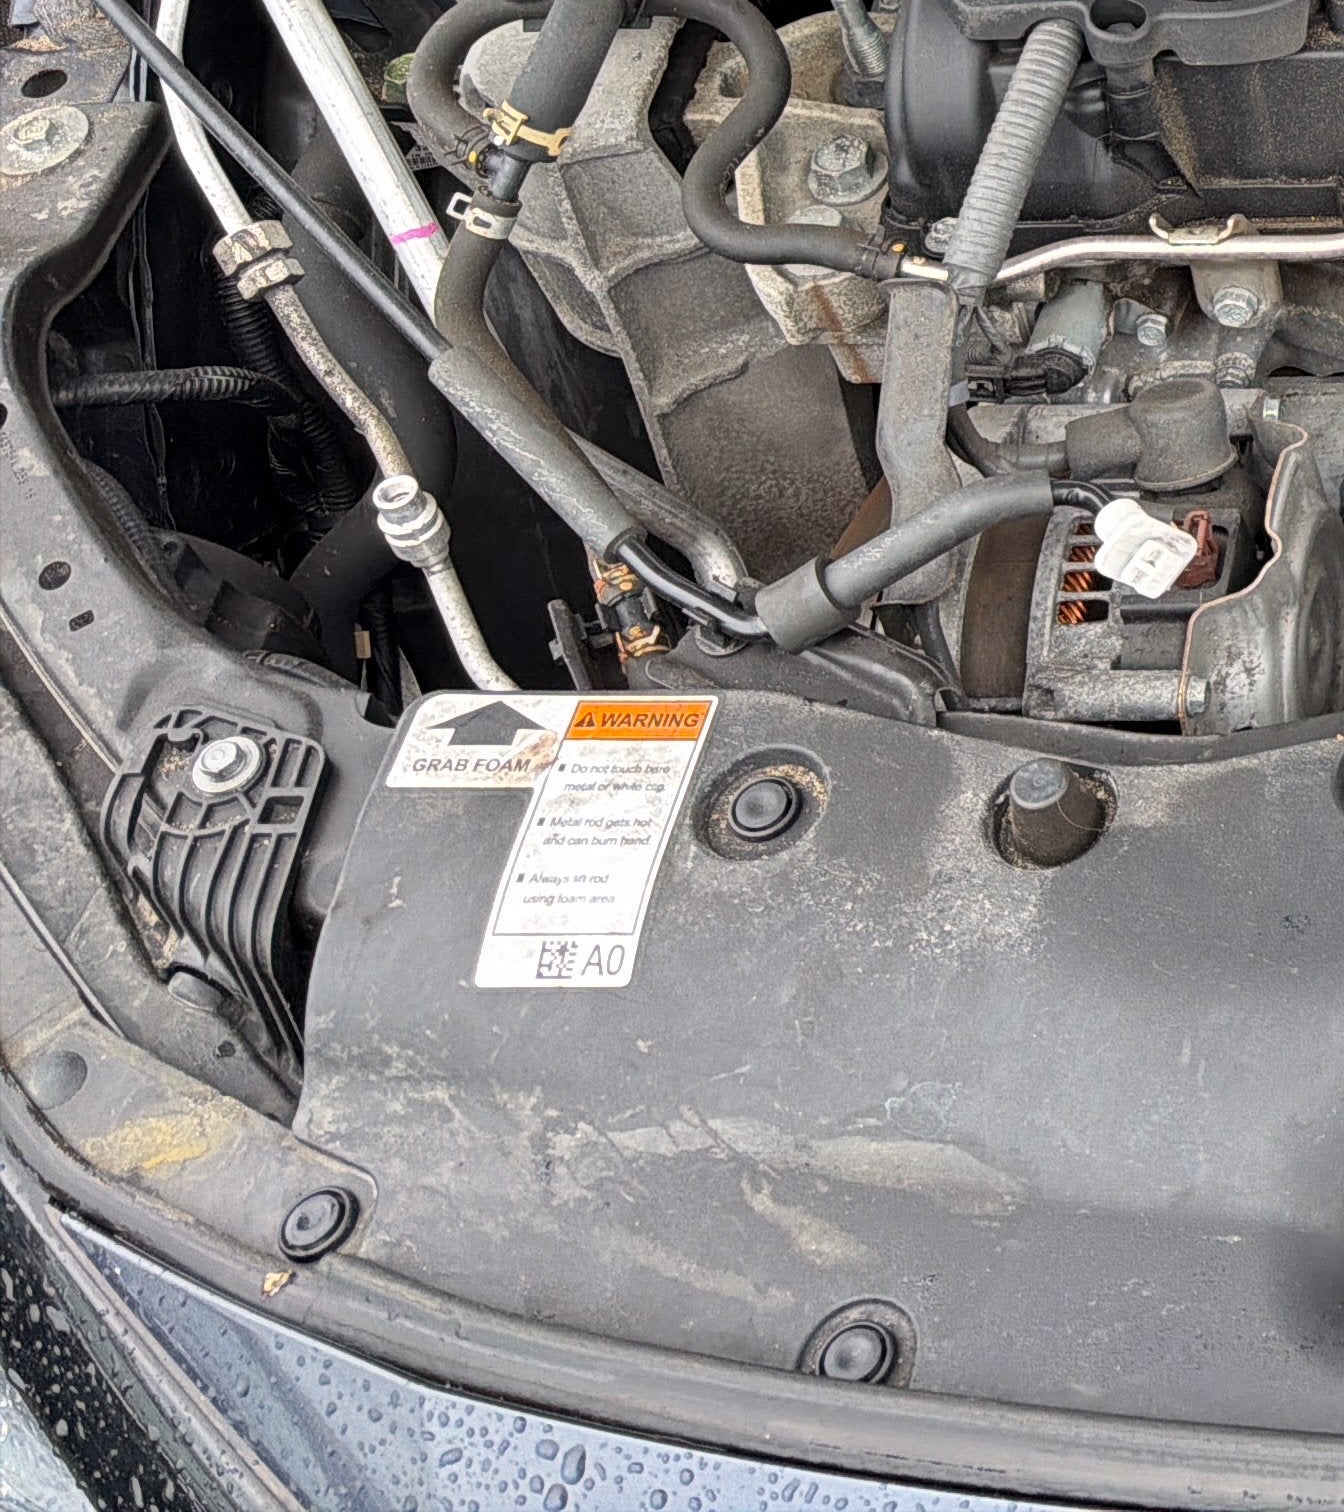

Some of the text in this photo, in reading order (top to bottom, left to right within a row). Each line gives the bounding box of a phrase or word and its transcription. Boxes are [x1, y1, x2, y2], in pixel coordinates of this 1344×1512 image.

[600, 712, 700, 728] WARNING
[411, 757, 532, 773] GRAB FOAM
[571, 763, 671, 775] Do not touch bare
[563, 781, 598, 792] metal
[613, 781, 643, 792] white
[549, 816, 653, 829] Metal rod gets hot
[542, 835, 566, 846] and
[566, 837, 589, 846] can
[529, 872, 570, 886] Always
[588, 873, 610, 884] rod
[522, 894, 556, 906] using
[556, 894, 587, 904] foam
[580, 944, 626, 977] A0
